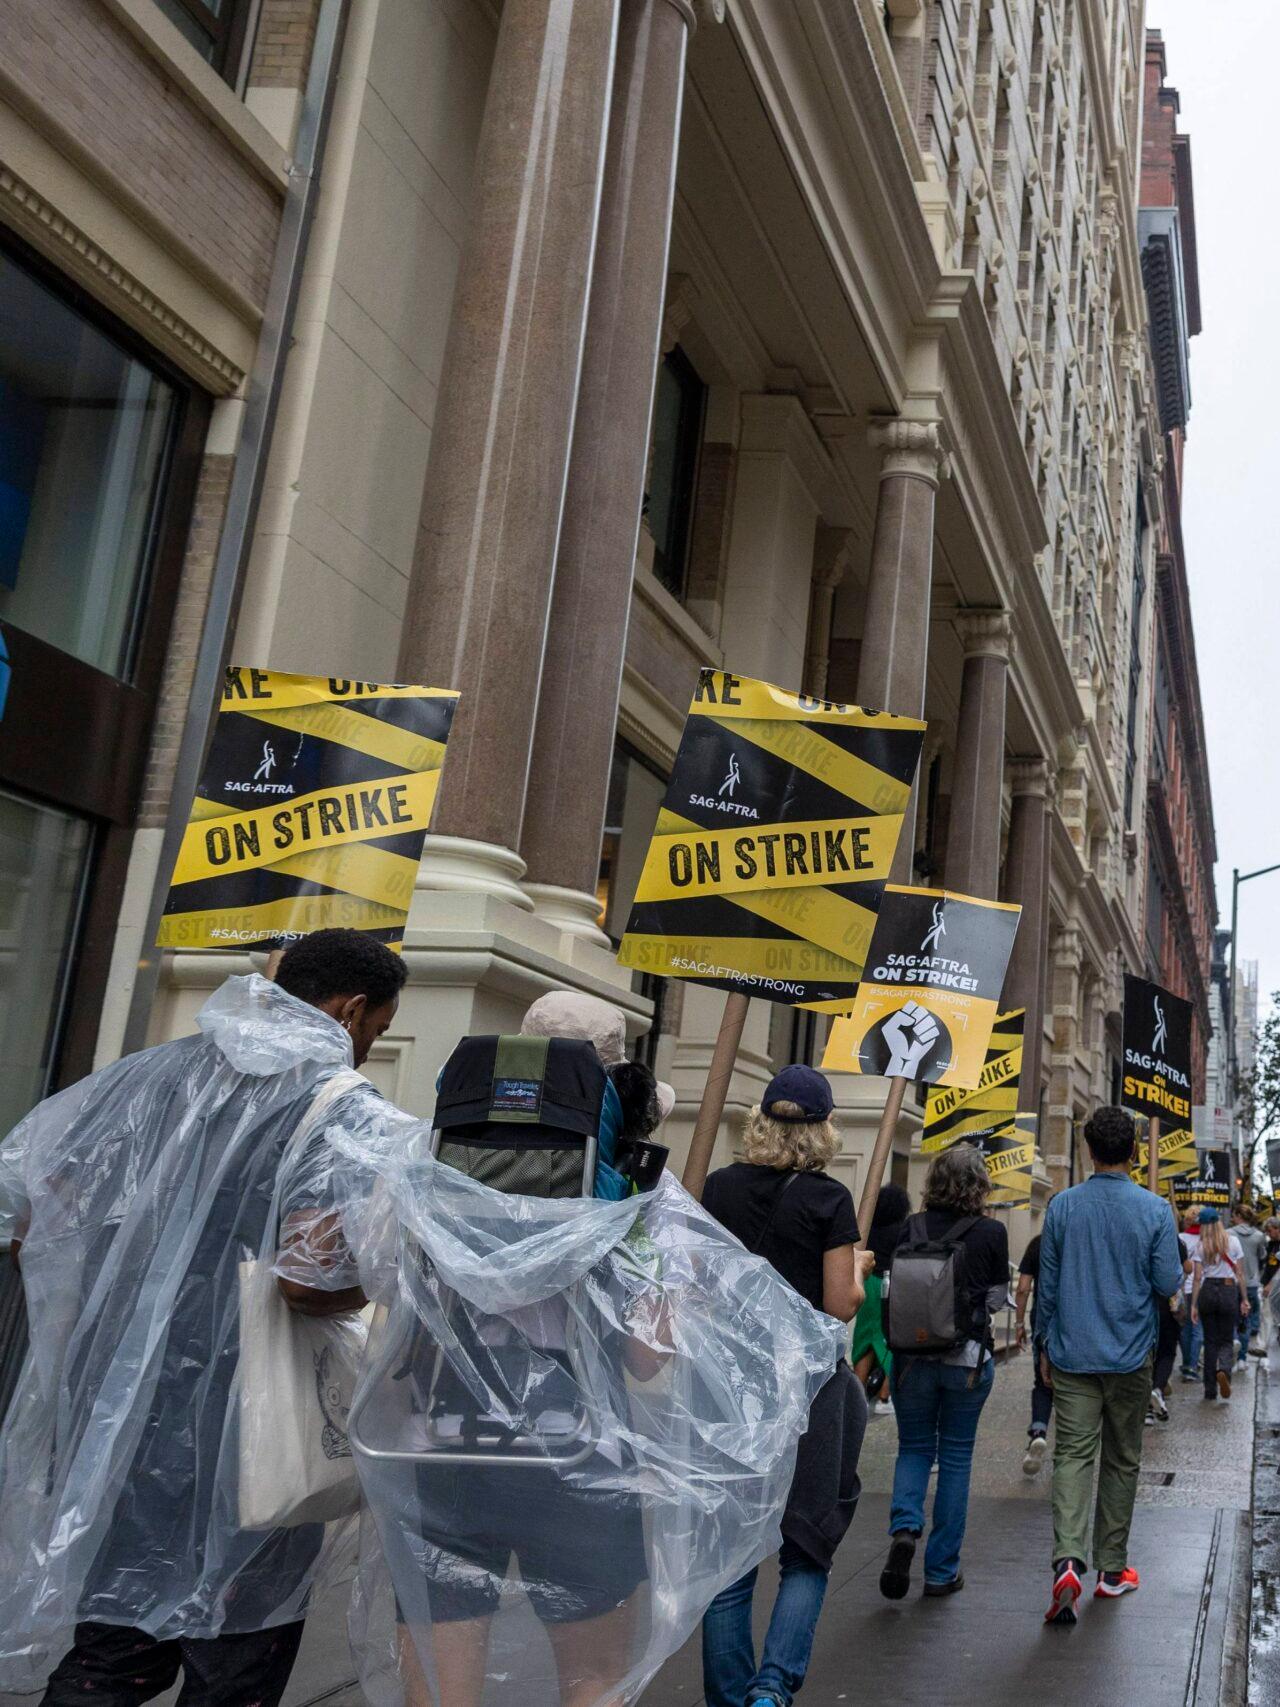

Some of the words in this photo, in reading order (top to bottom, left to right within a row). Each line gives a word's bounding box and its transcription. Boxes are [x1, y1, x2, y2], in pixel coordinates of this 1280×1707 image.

[205, 820, 261, 866] ON
[272, 784, 413, 850] STRIKE
[668, 840, 720, 887] ON
[734, 828, 874, 884] STRIKE
[671, 956, 805, 996] #SAGAFTRASTRONG
[873, 966, 902, 981] ON
[905, 968, 979, 992] STRIKE!
[870, 987, 973, 1008] #SAGAFTRASTRONG
[934, 1090, 956, 1115] ON
[959, 1057, 1014, 1099] SRIKE
[1124, 1075, 1190, 1118] STRIKE!
[1153, 1073, 1166, 1085] ON
[986, 1148, 1028, 1175] STRIKE
